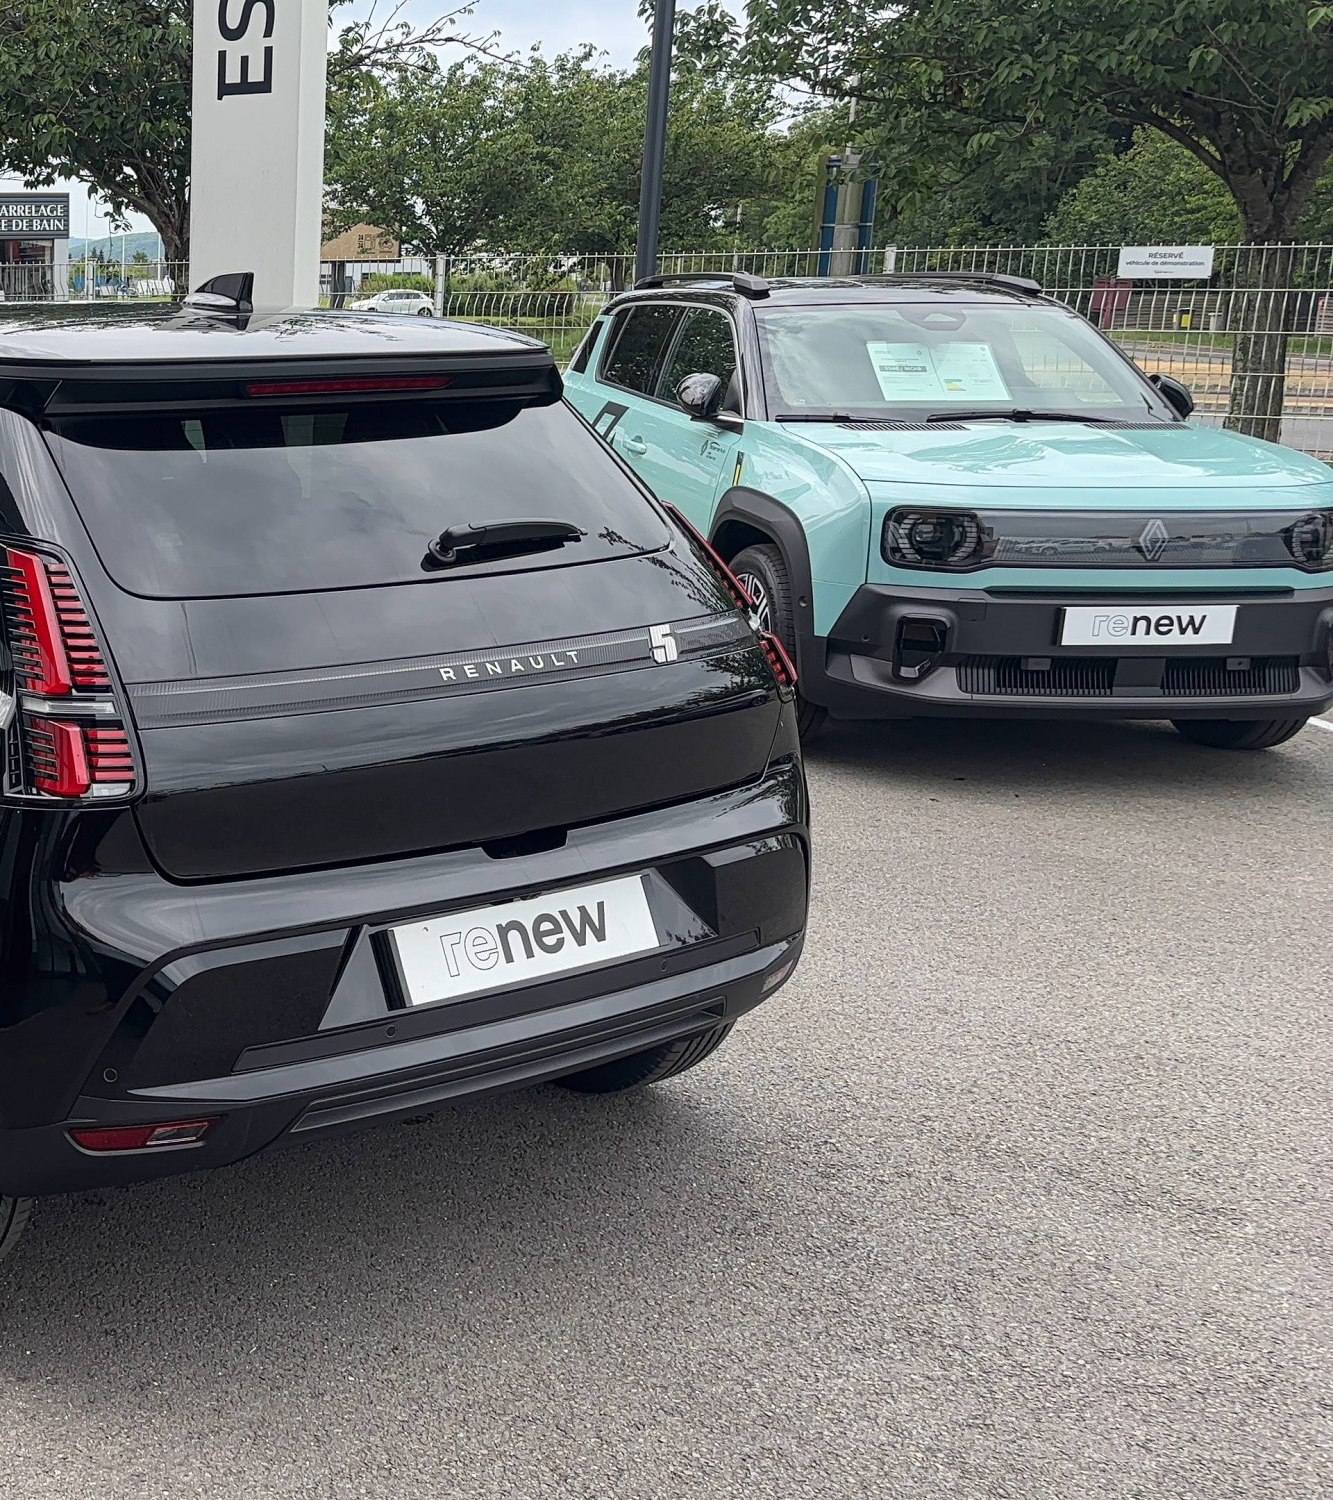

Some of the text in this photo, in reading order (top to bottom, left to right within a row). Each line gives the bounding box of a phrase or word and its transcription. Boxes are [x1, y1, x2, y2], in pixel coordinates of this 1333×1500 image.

[217, 0, 275, 101] ES
[12, 219, 29, 231] DE
[32, 219, 64, 231] BAIN
[1148, 251, 1184, 259] RÉSERVÉ
[1160, 259, 1205, 267] démonstration
[1092, 614, 1207, 637] renew
[648, 622, 678, 664] 5
[438, 650, 579, 682] RENAULT
[439, 900, 607, 978] renew
